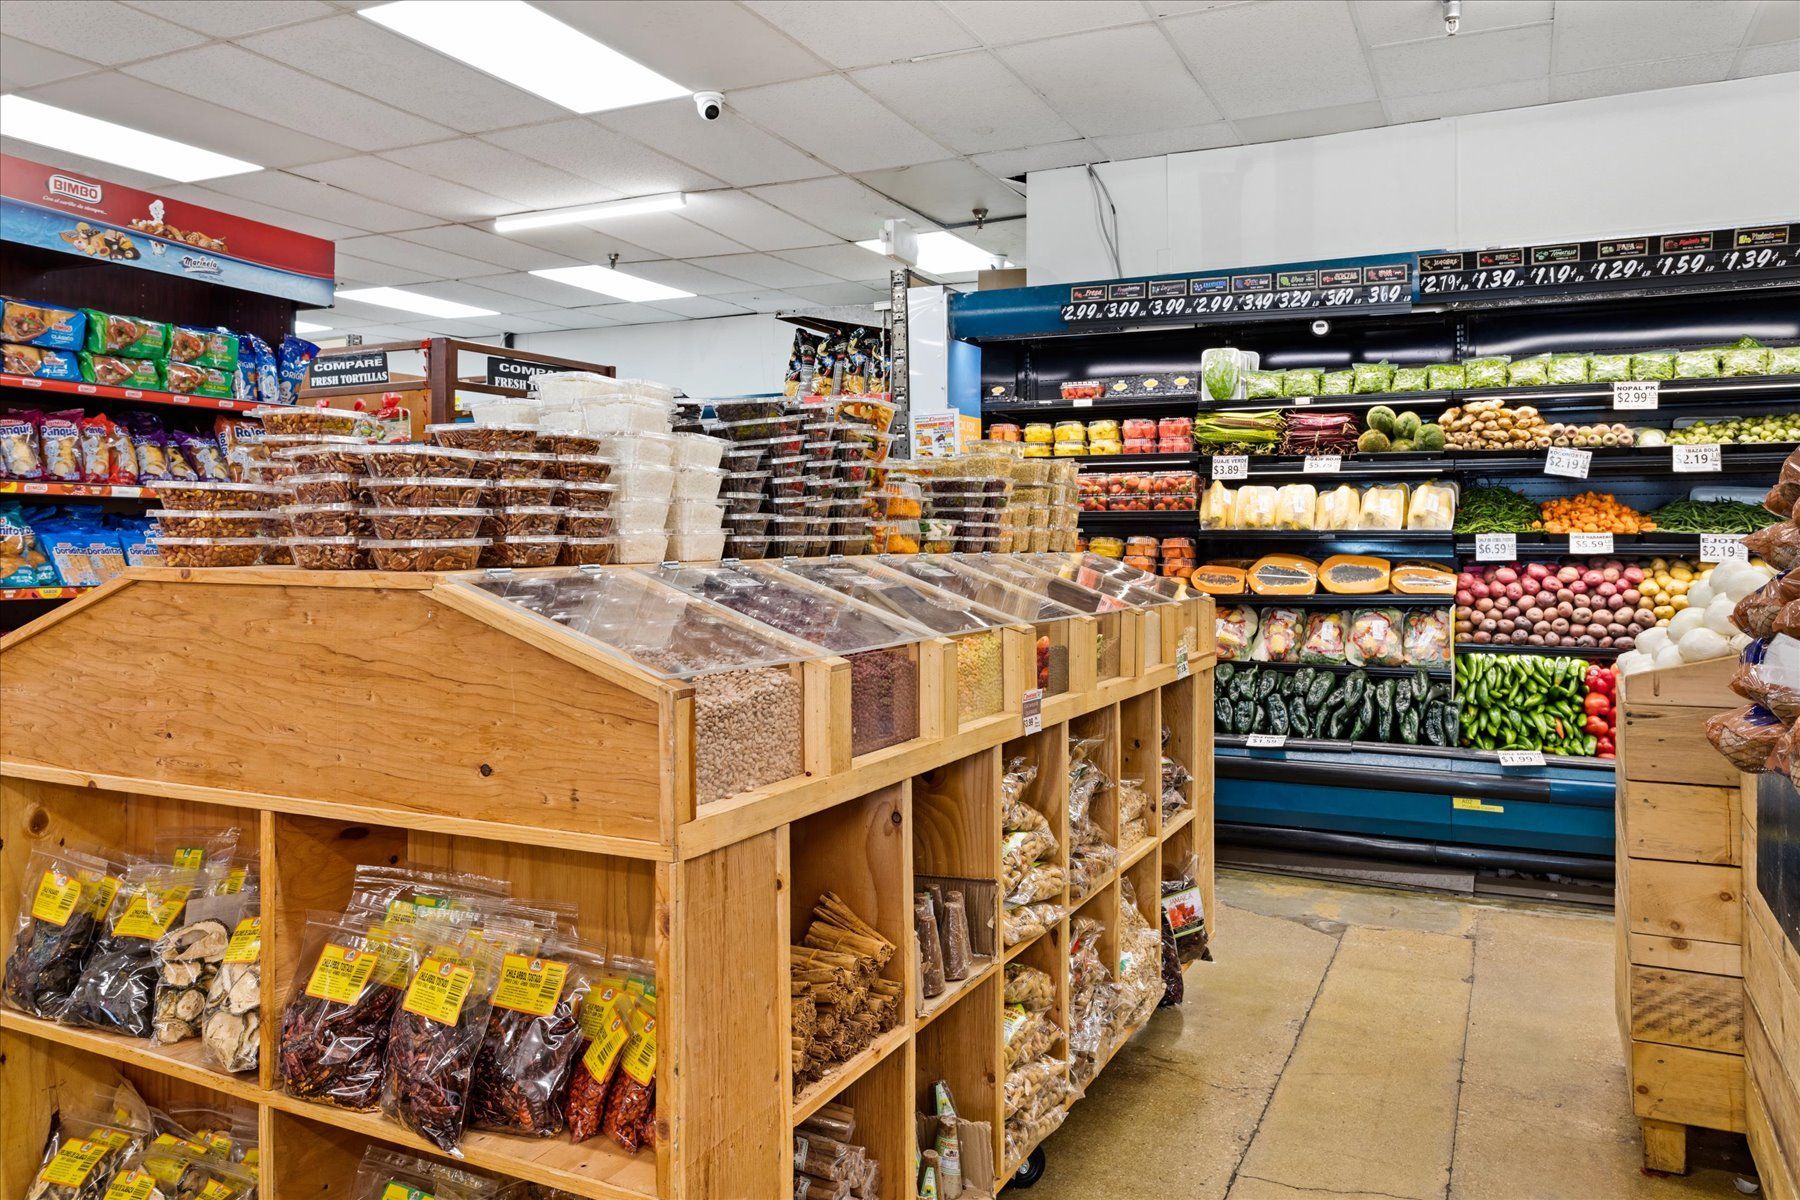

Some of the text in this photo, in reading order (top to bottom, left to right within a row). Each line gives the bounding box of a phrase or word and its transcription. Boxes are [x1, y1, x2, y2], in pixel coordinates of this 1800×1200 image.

[54, 179, 98, 199] BIMBO
[1616, 243, 1635, 251] PAPA
[183, 256, 218, 268] Marinela
[1084, 289, 1104, 297] Fresa
[313, 358, 384, 372] COMPARE
[499, 363, 561, 376] COMPA
[310, 371, 388, 387] FRESH TORTILLAS
[494, 376, 527, 390] FRESH
[1617, 392, 1647, 403] $2.99
[0, 423, 32, 436] anqué
[41, 424, 78, 437] Panqué
[1549, 455, 1579, 470] $2.19
[1675, 454, 1708, 464] $2.19
[1213, 465, 1239, 475] $3.89
[1478, 543, 1506, 554] $6.59
[1576, 540, 1604, 548] $5.59
[88, 547, 122, 555] Doraditas
[1702, 545, 1735, 557] $2.19
[1169, 892, 1195, 904] JAMAICA
[322, 958, 333, 968] CHILE
[341, 962, 355, 973] TOSTADO
[419, 971, 428, 981] CHILE
[436, 976, 450, 988] TOSTADO
[506, 968, 543, 983] CHILE ARBOL TOSTADO
